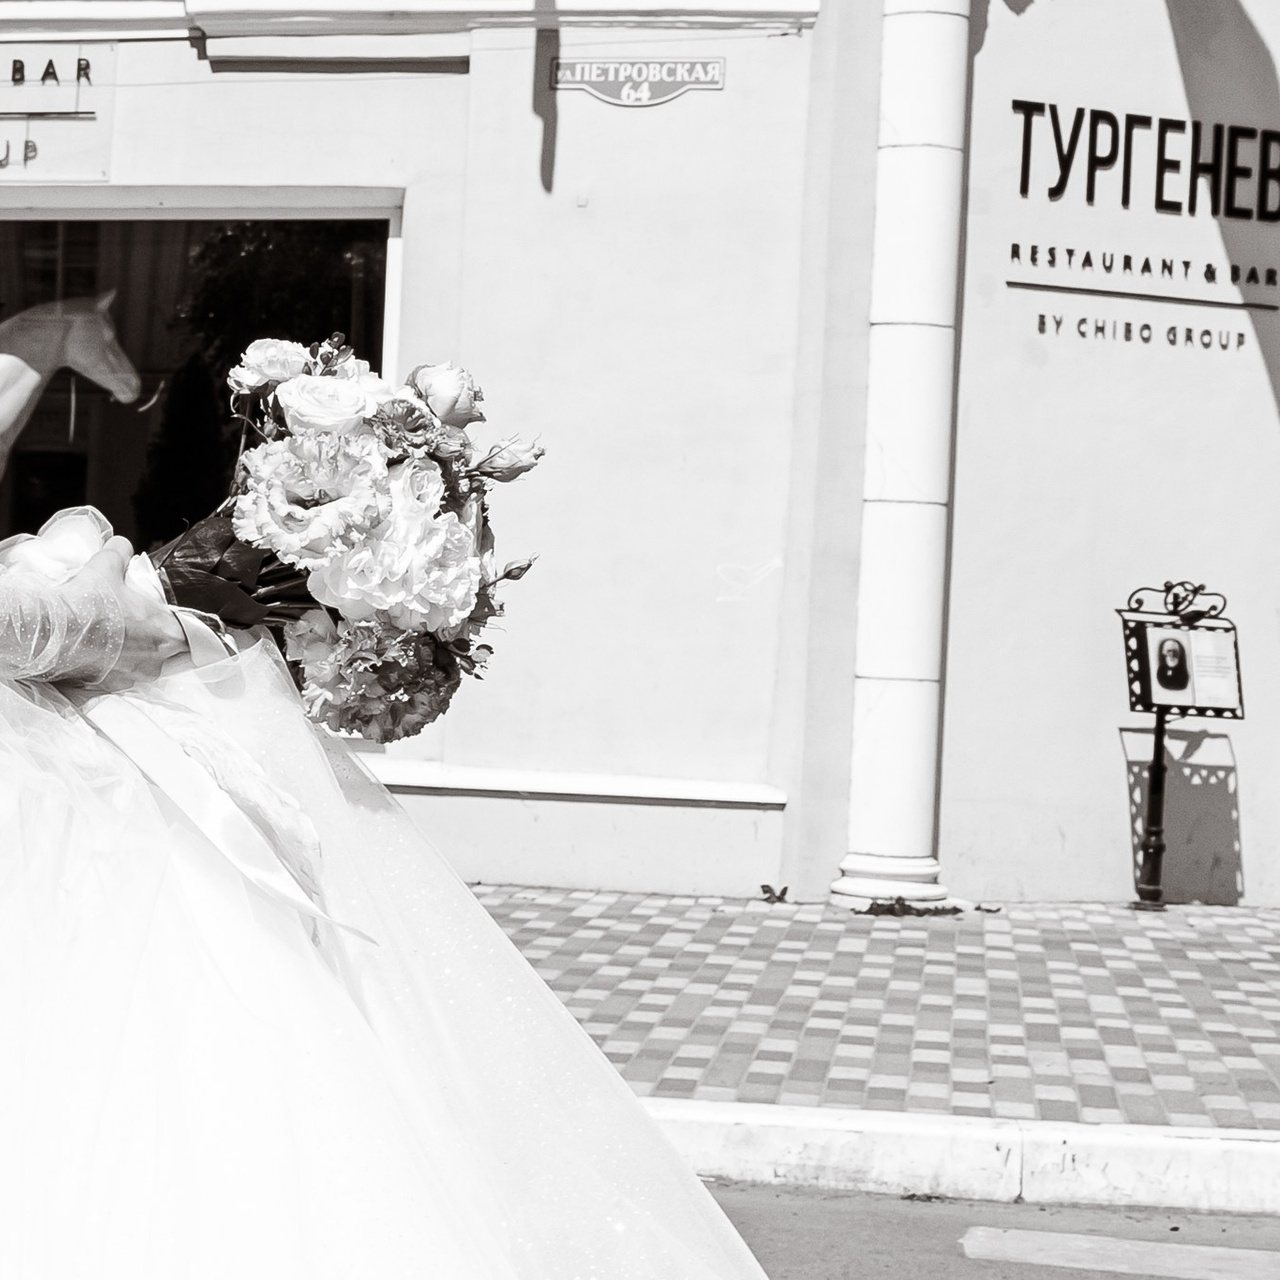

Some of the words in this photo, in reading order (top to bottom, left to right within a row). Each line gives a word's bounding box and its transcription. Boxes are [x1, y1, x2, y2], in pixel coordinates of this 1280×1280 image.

[11, 59, 92, 86] BAR
[575, 62, 721, 82] ПЕТРОВСКАЯ
[620, 81, 652, 103] 64
[1011, 99, 1280, 222] ТУРГЕНЕВ
[1010, 243, 1192, 278] RESTAURANT
[1230, 264, 1278, 286] BAR
[1037, 314, 1063, 336] BY
[1076, 317, 1153, 344] CHIBO
[1166, 325, 1246, 352] GROUP
